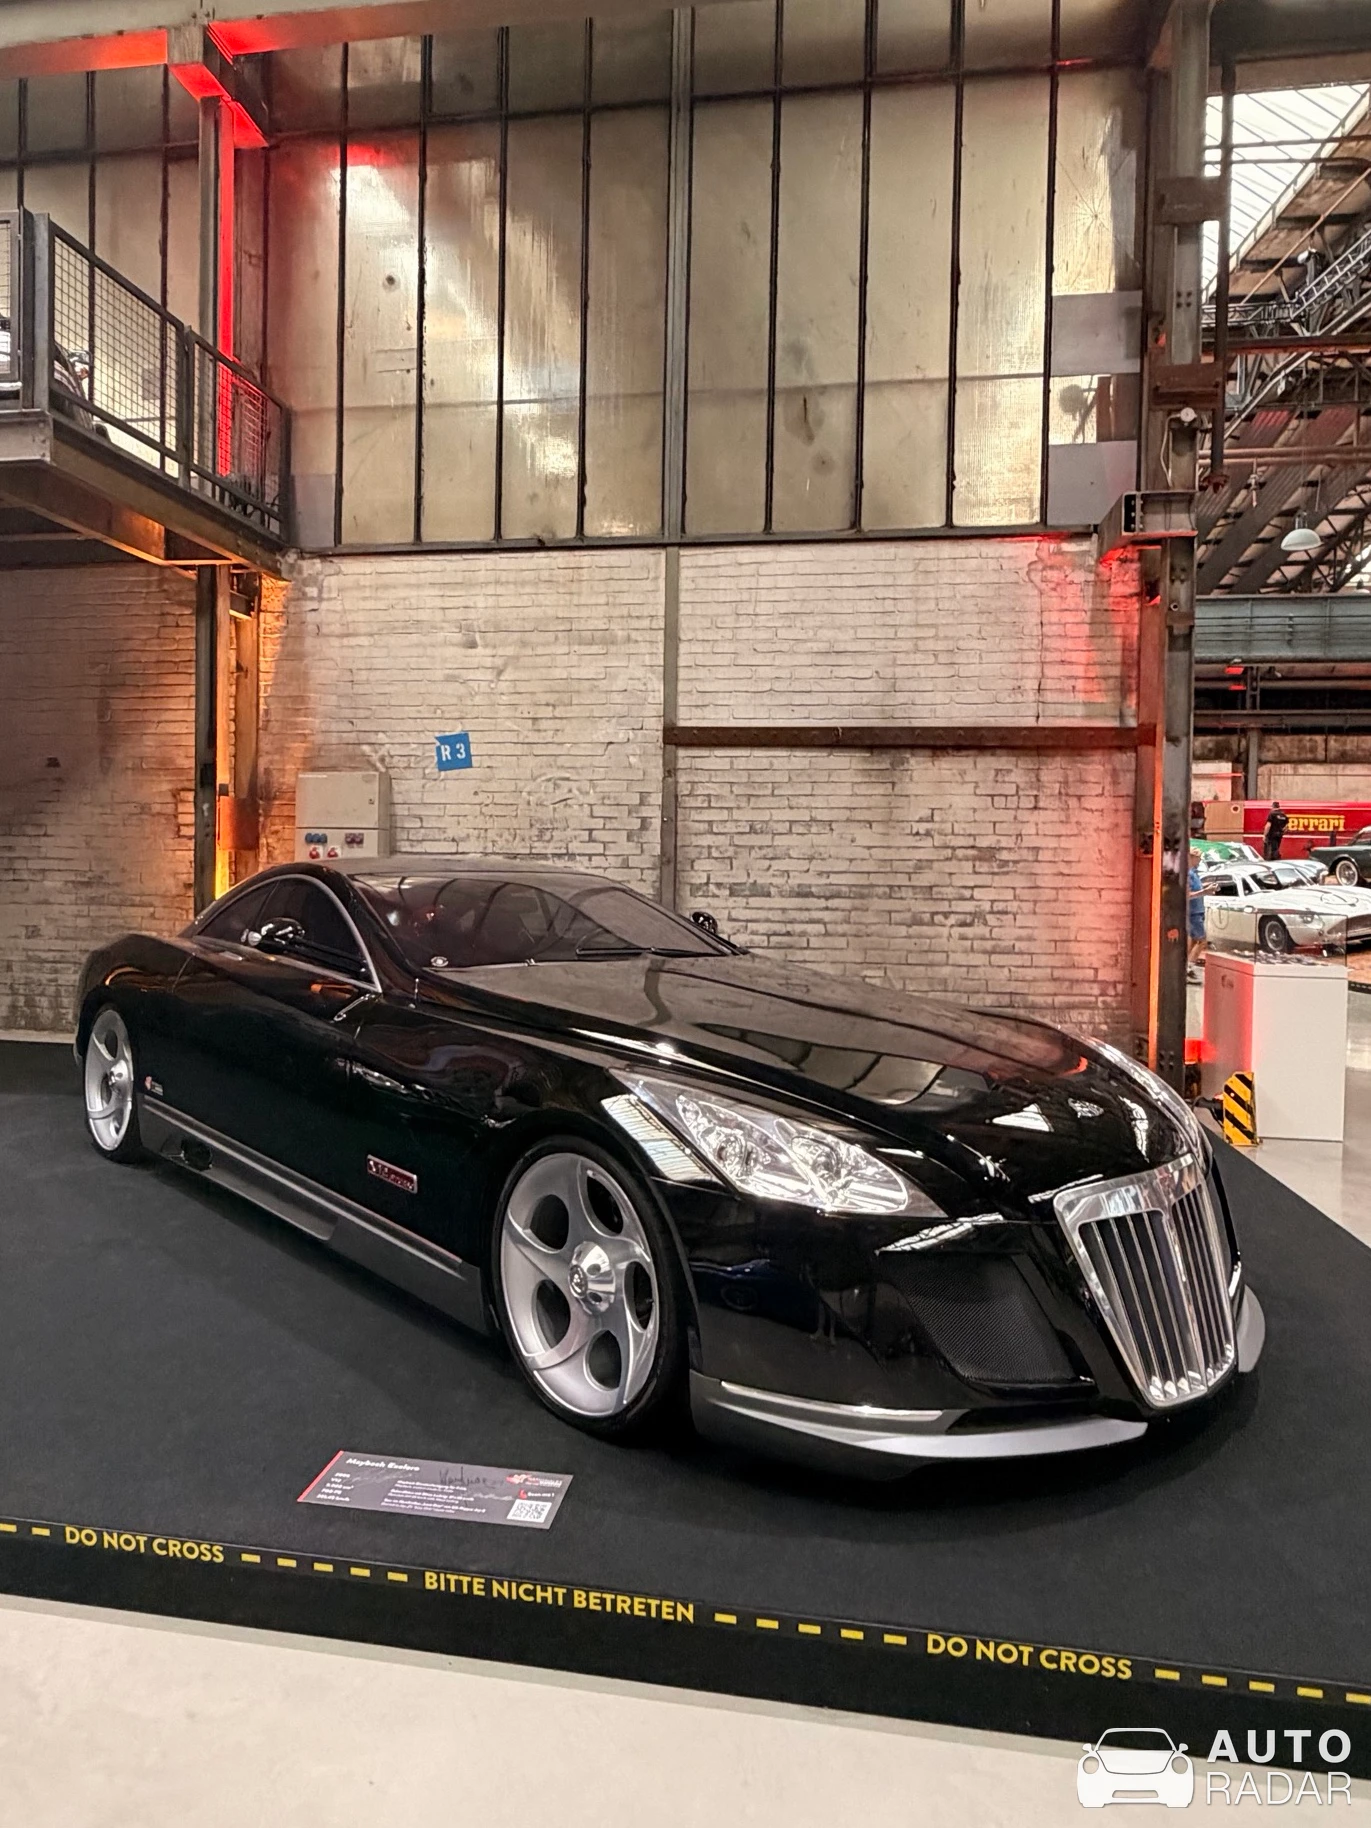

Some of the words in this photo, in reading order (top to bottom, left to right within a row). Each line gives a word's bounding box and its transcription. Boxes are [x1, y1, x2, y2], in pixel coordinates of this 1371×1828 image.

[441, 744, 451, 761] R
[456, 743, 466, 760] 3
[1285, 814, 1346, 831] errari
[64, 1525, 97, 1547] DO
[103, 1533, 148, 1555] NOT
[153, 1540, 224, 1563] CROSS
[424, 1571, 485, 1597] BITTE
[492, 1580, 567, 1606] NICHT
[573, 1589, 694, 1624] BETRETEN
[926, 1633, 969, 1657] DO
[975, 1641, 1034, 1667] NOT
[1039, 1648, 1132, 1680] CROSS
